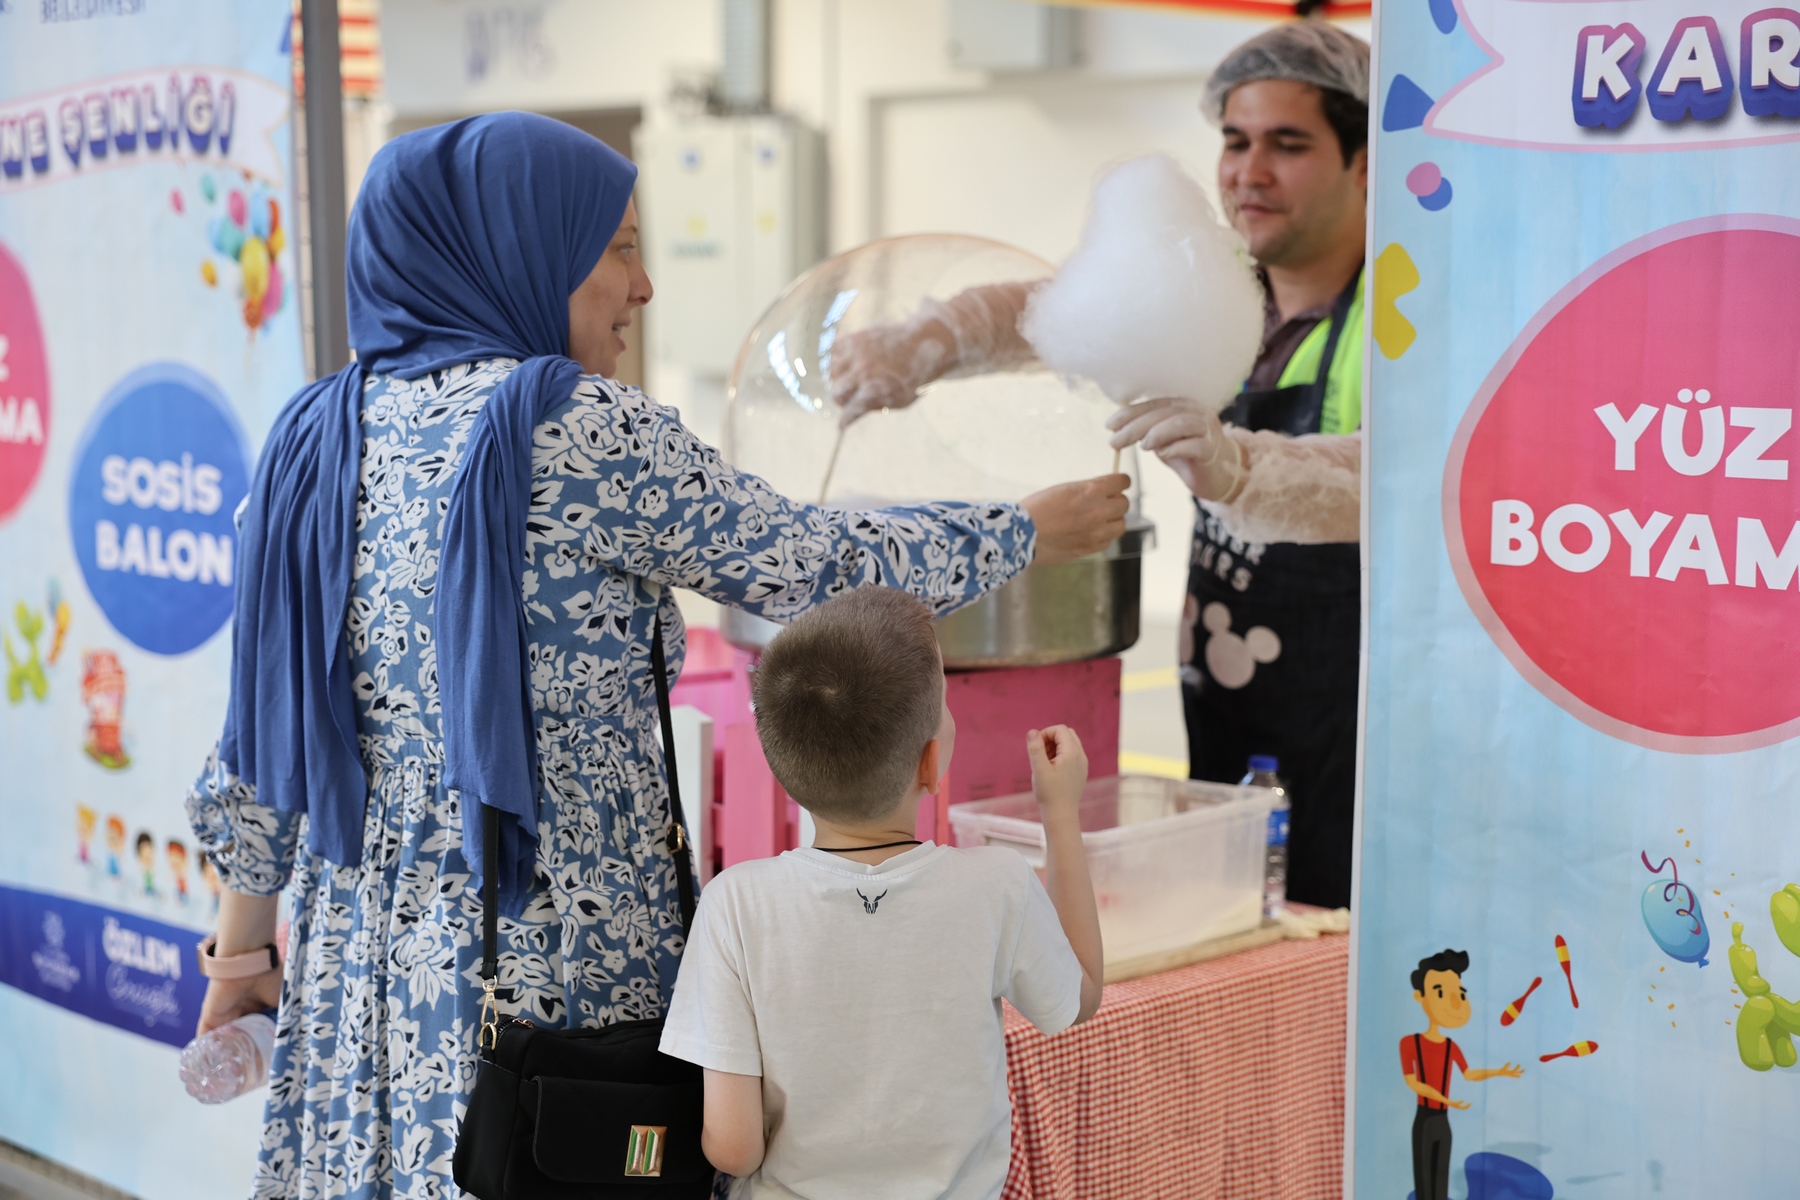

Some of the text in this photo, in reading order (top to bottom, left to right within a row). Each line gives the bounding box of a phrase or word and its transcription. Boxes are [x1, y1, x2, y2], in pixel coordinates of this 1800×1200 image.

[1572, 8, 1800, 128] KAR
[1594, 388, 1793, 481] YÜZ
[102, 451, 223, 515] SOSİS
[96, 519, 233, 587] BALON
[1490, 499, 1800, 590] BOYAM
